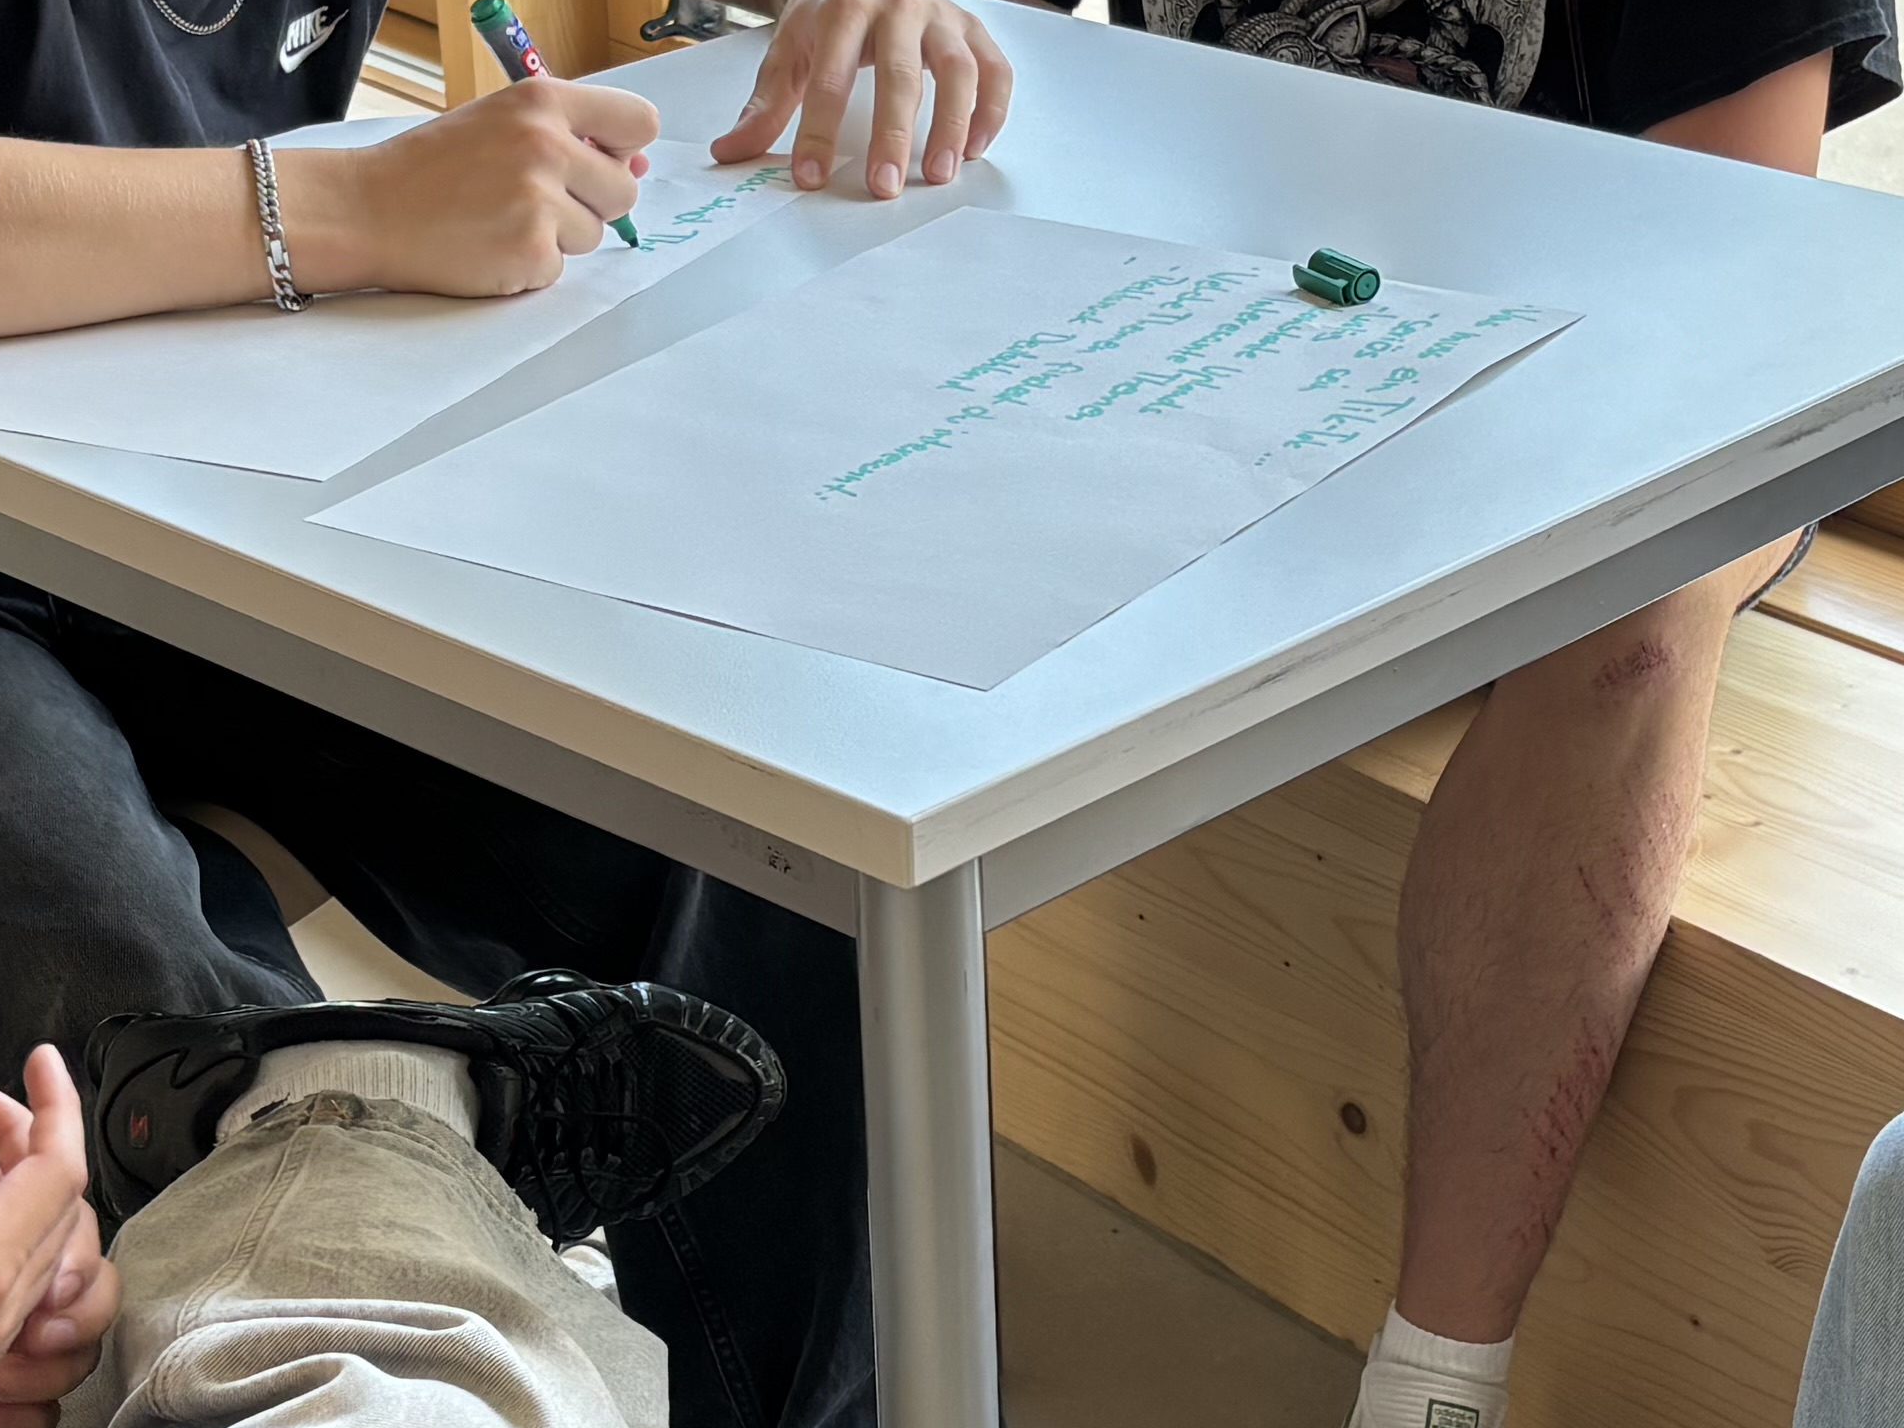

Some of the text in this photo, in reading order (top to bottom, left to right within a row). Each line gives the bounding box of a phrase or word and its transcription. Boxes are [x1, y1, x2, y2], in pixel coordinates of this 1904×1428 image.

[286, 5, 328, 53] NIKE
[672, 195, 737, 225] sind
[1077, 312, 1194, 353] Themen
[1065, 370, 1183, 423] Themen
[1366, 366, 1421, 393] ein
[947, 405, 994, 424] du
